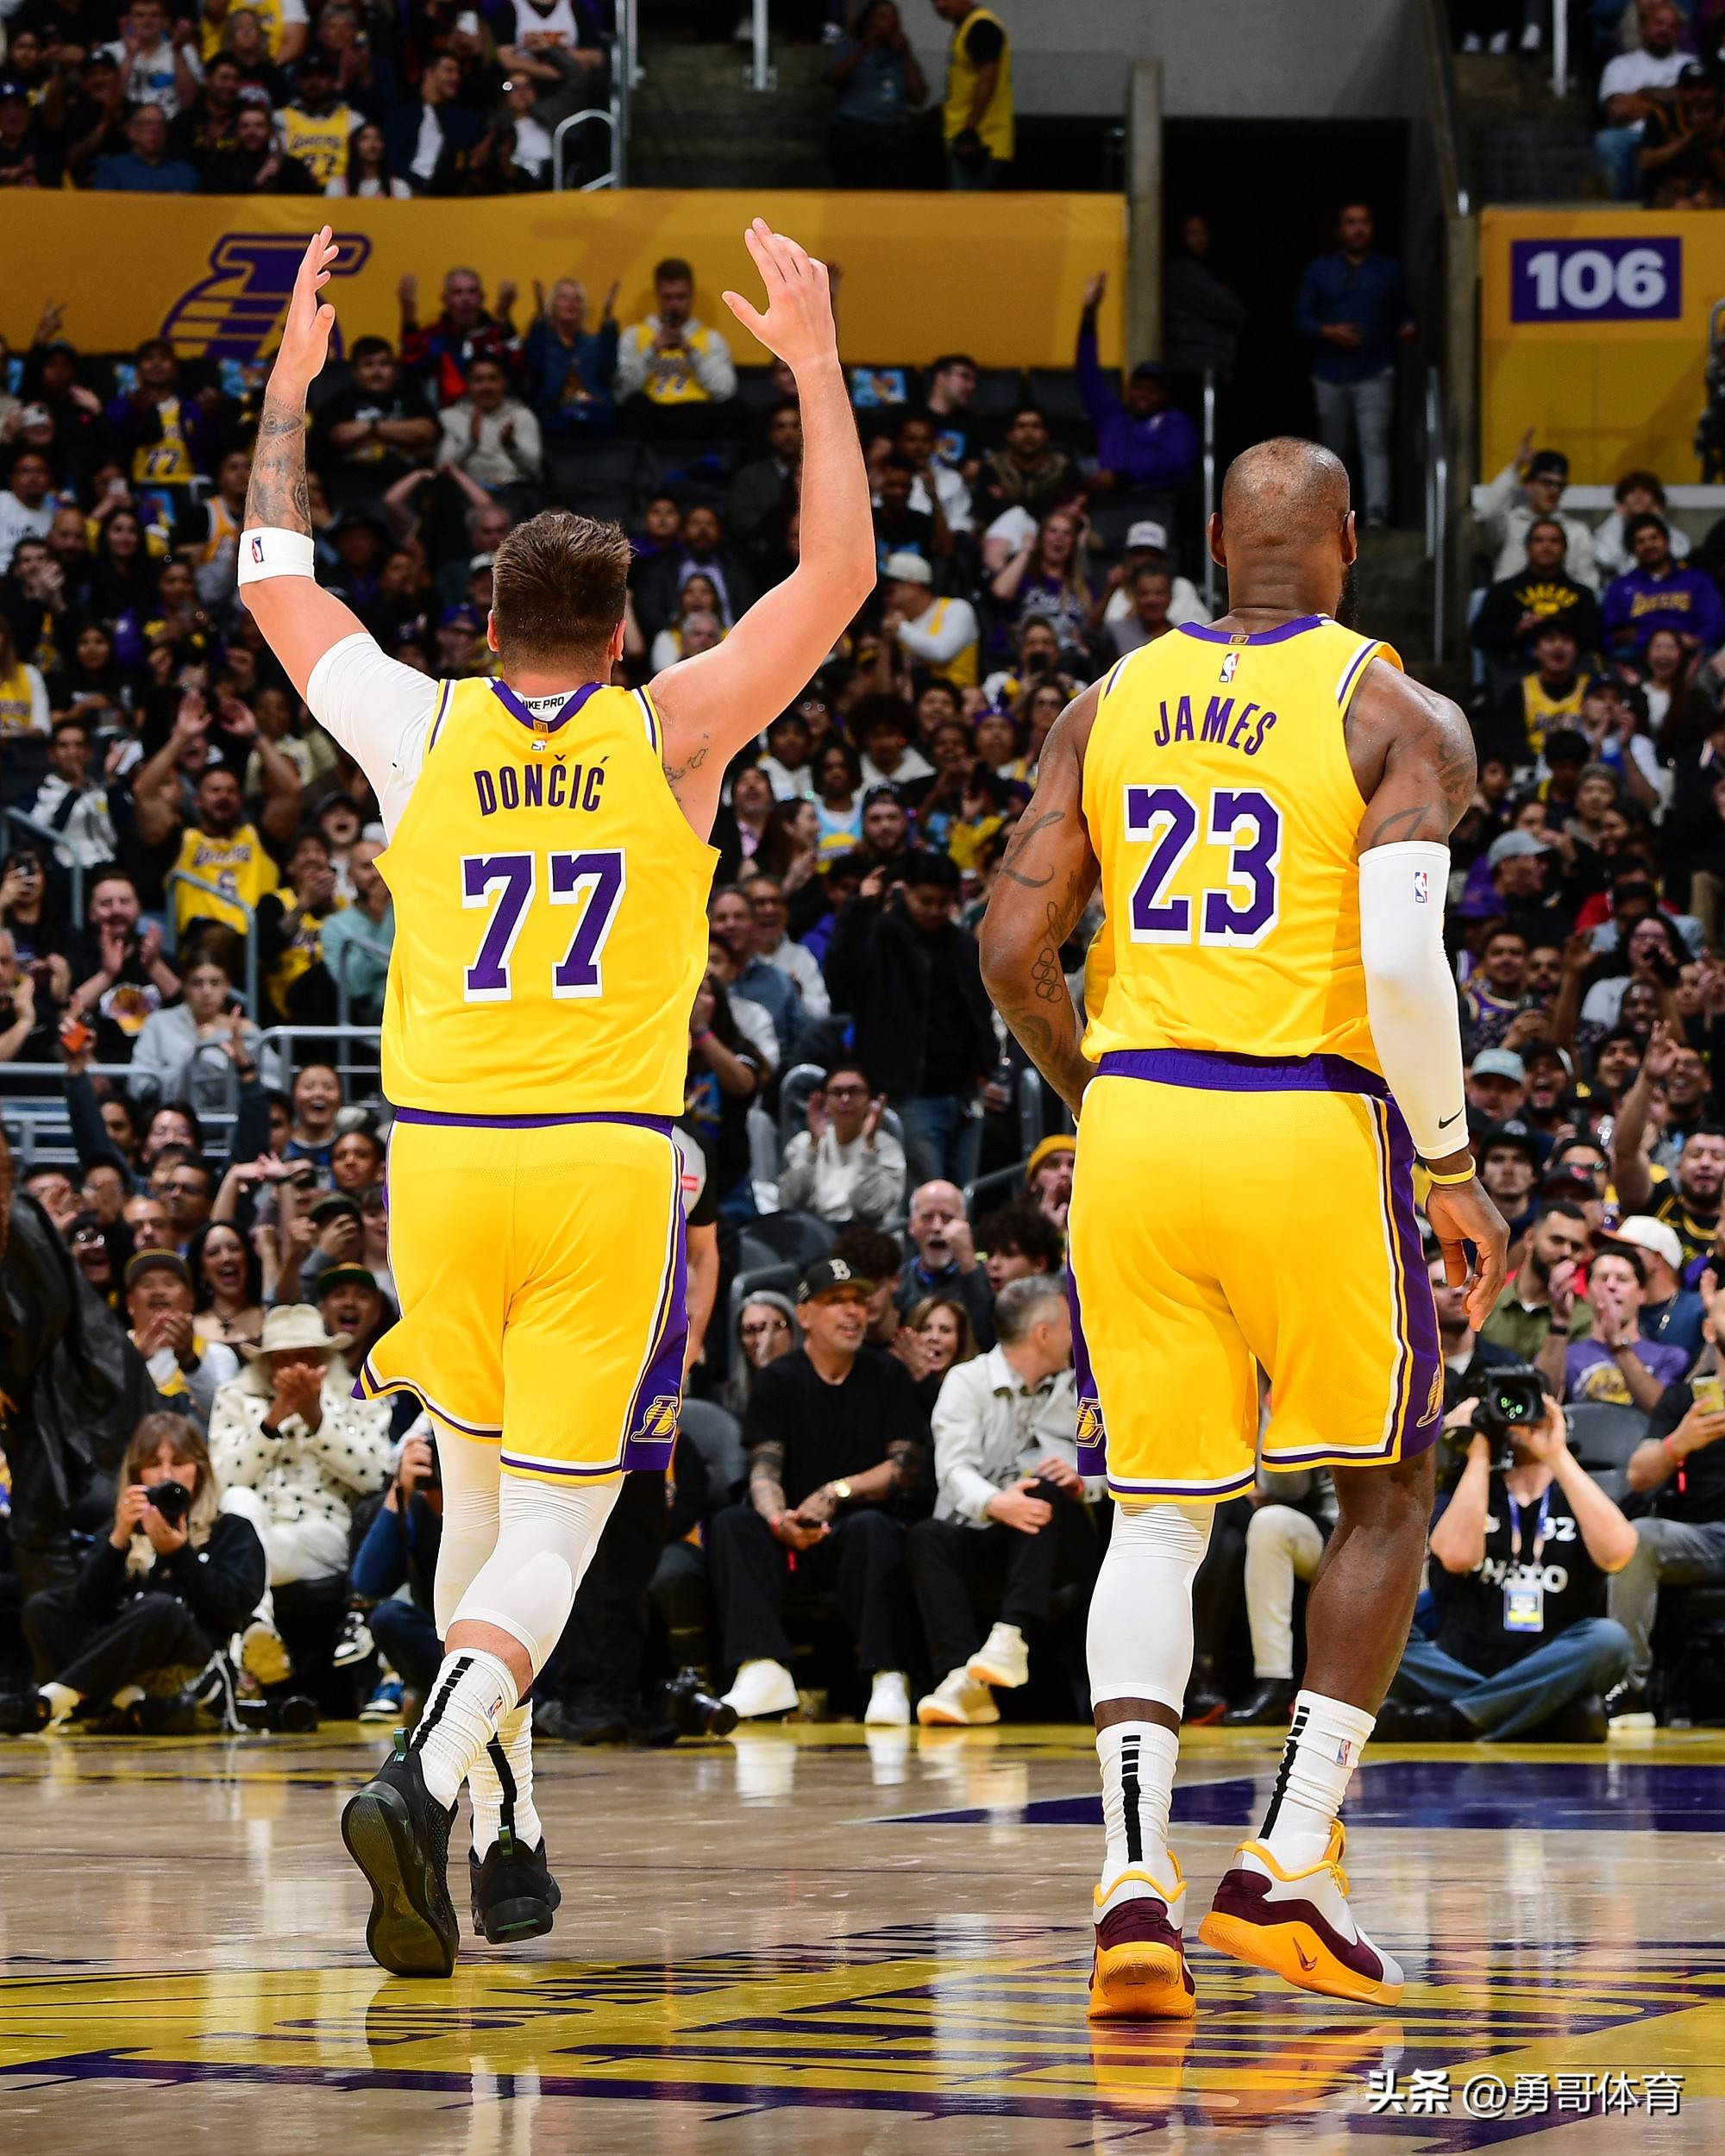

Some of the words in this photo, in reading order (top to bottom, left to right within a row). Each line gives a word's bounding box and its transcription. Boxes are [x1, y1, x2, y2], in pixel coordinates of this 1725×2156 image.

[1526, 248, 1666, 310] 106
[523, 699, 542, 710] IKE
[543, 696, 565, 709] PRO
[1153, 695, 1277, 755] JAMES
[474, 754, 611, 817] DONČIĆ
[1124, 786, 1283, 948] 23
[461, 849, 626, 1001] 77
[828, 1258, 851, 1281] B
